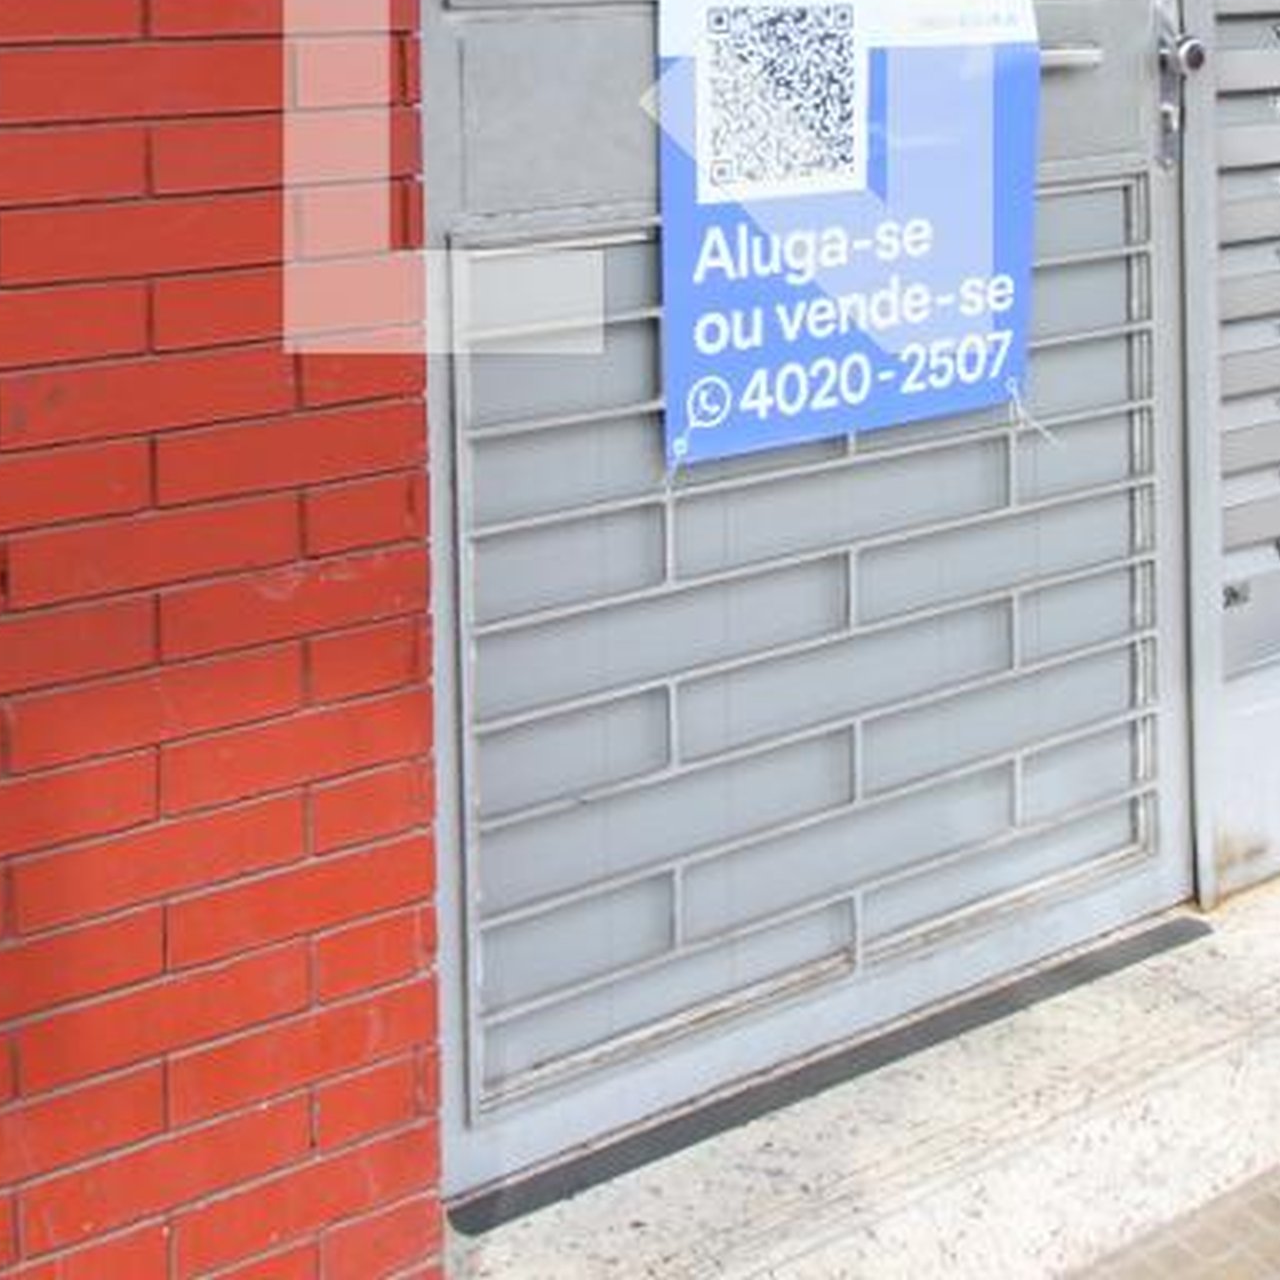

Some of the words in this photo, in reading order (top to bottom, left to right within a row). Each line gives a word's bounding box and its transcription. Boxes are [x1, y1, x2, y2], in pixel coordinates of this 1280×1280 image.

[693, 217, 933, 284] Aluga-se
[693, 310, 763, 355] ou
[776, 273, 1015, 341] vende-se
[739, 330, 1013, 419] 4020-2507
